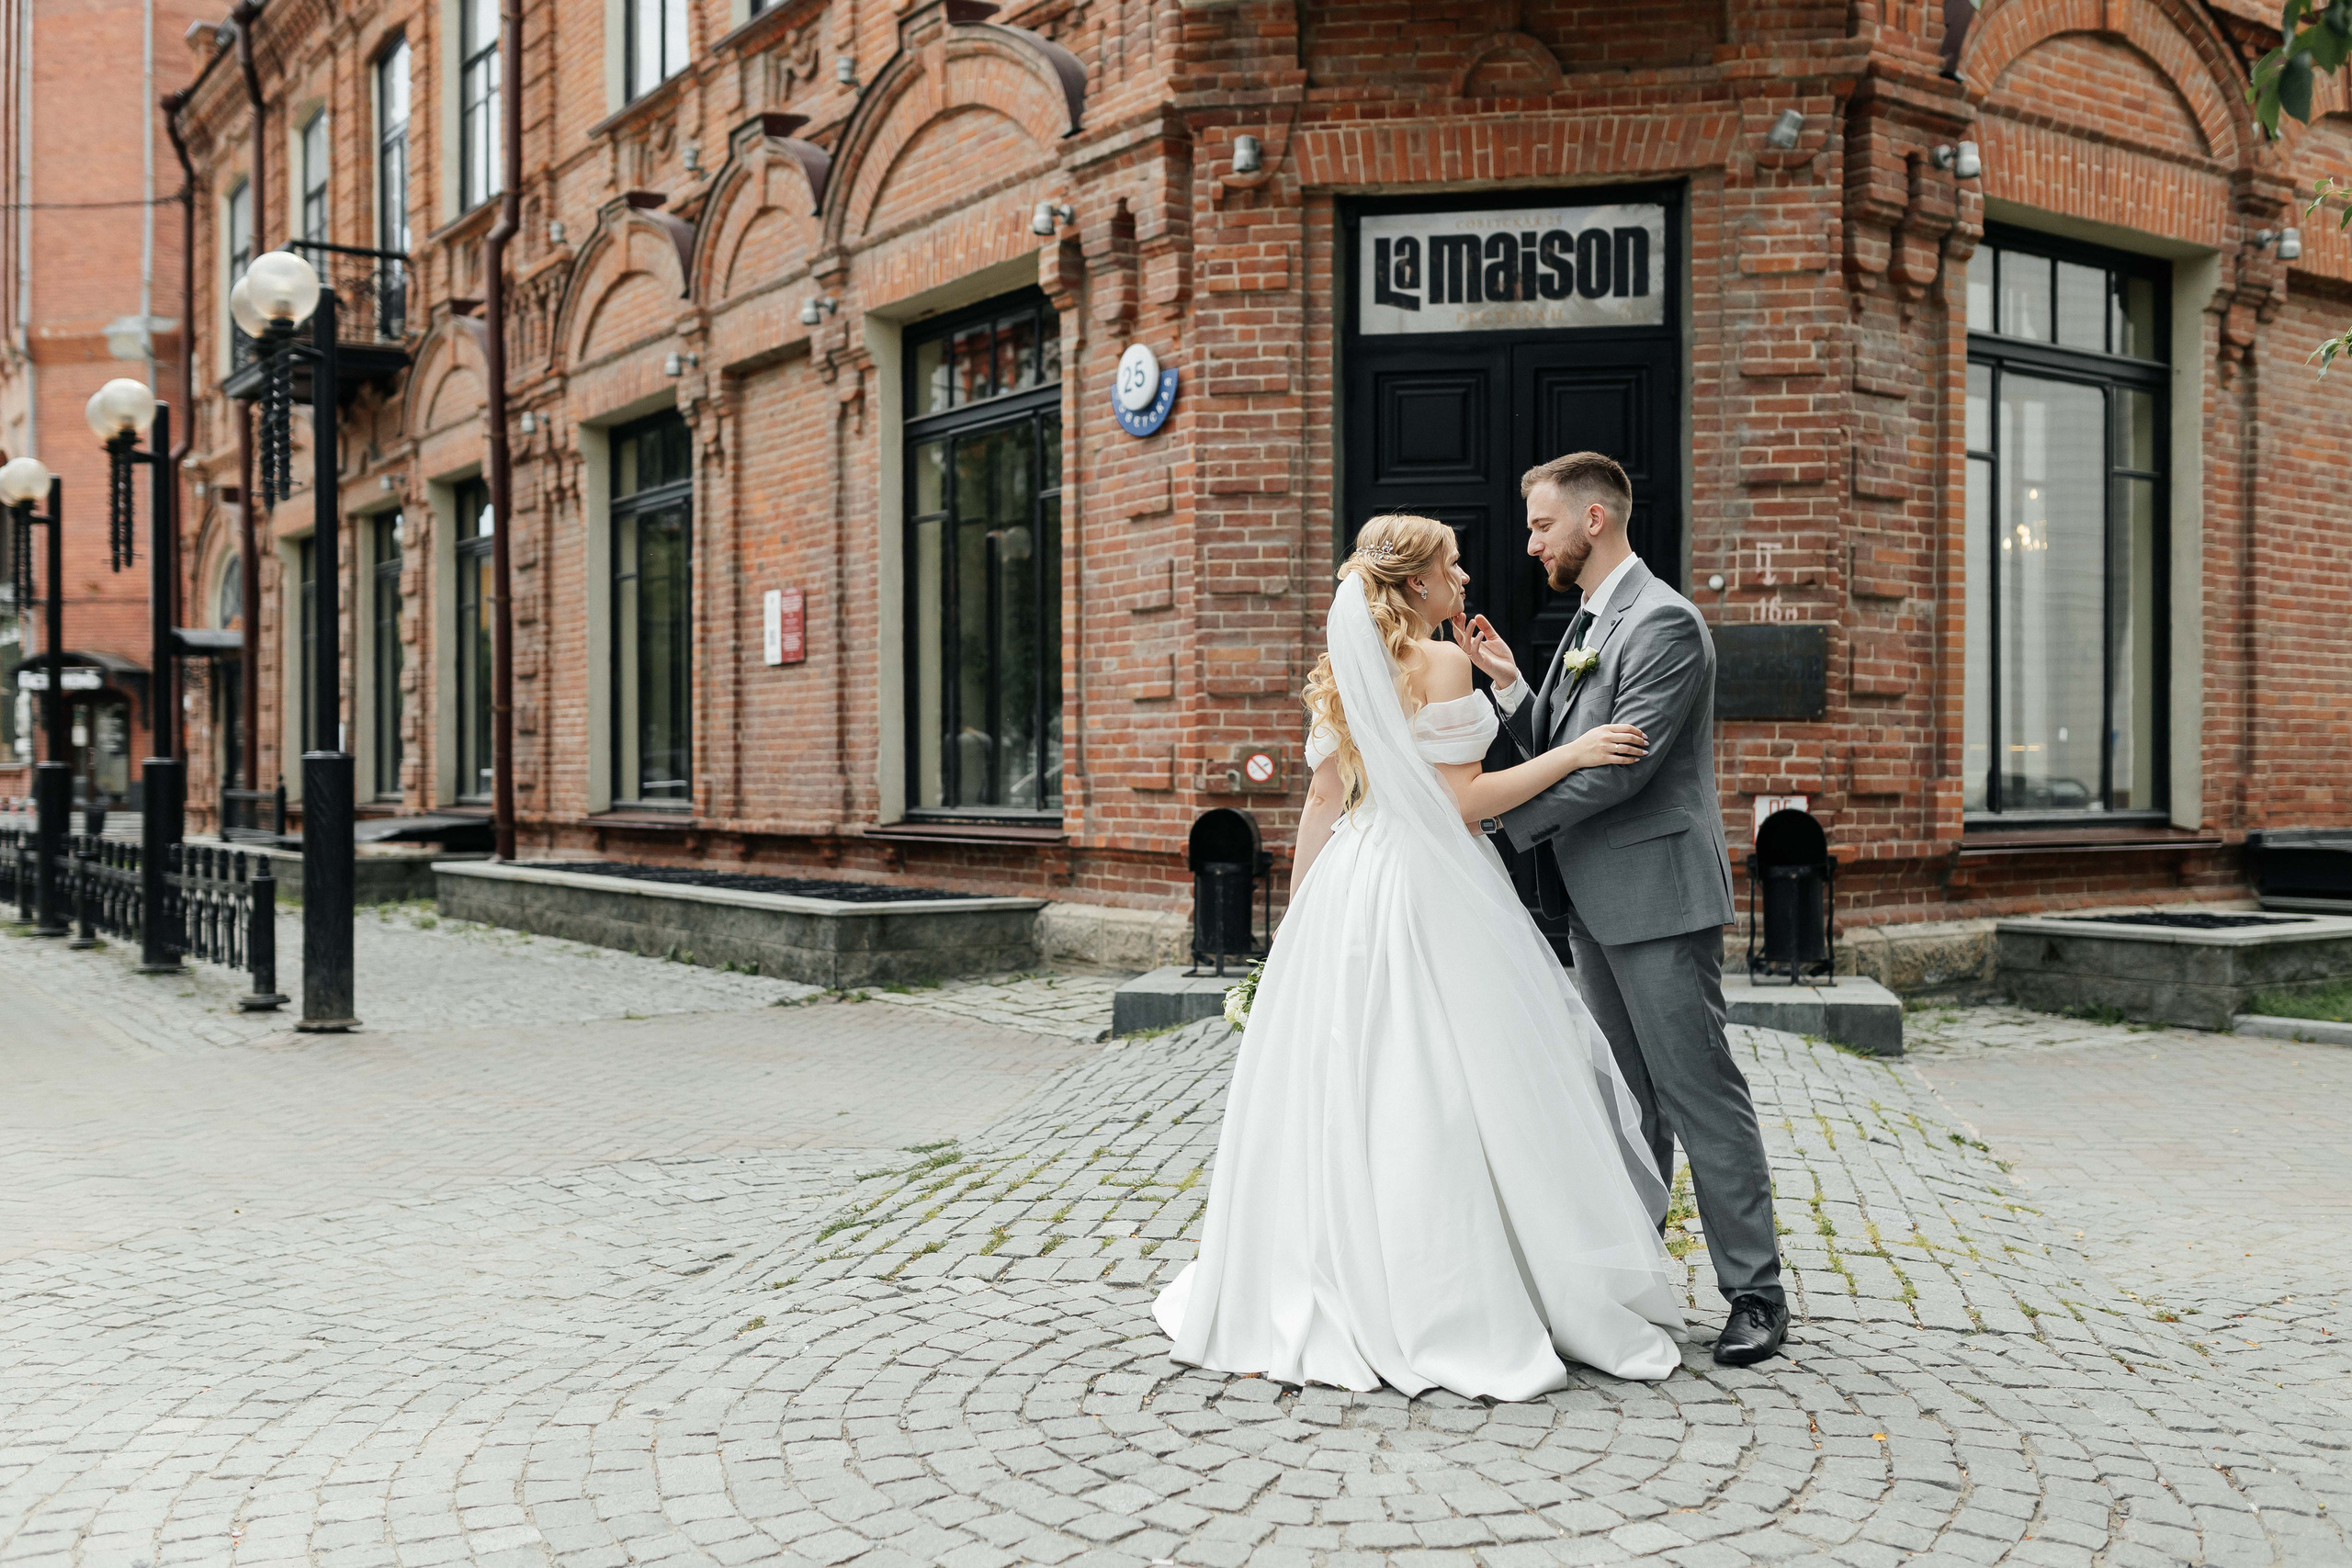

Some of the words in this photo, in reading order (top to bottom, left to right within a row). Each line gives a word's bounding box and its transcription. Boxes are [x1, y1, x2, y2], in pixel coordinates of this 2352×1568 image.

[1374, 235, 1420, 311] La
[1429, 226, 1650, 304] maison
[1123, 359, 1145, 393] 25
